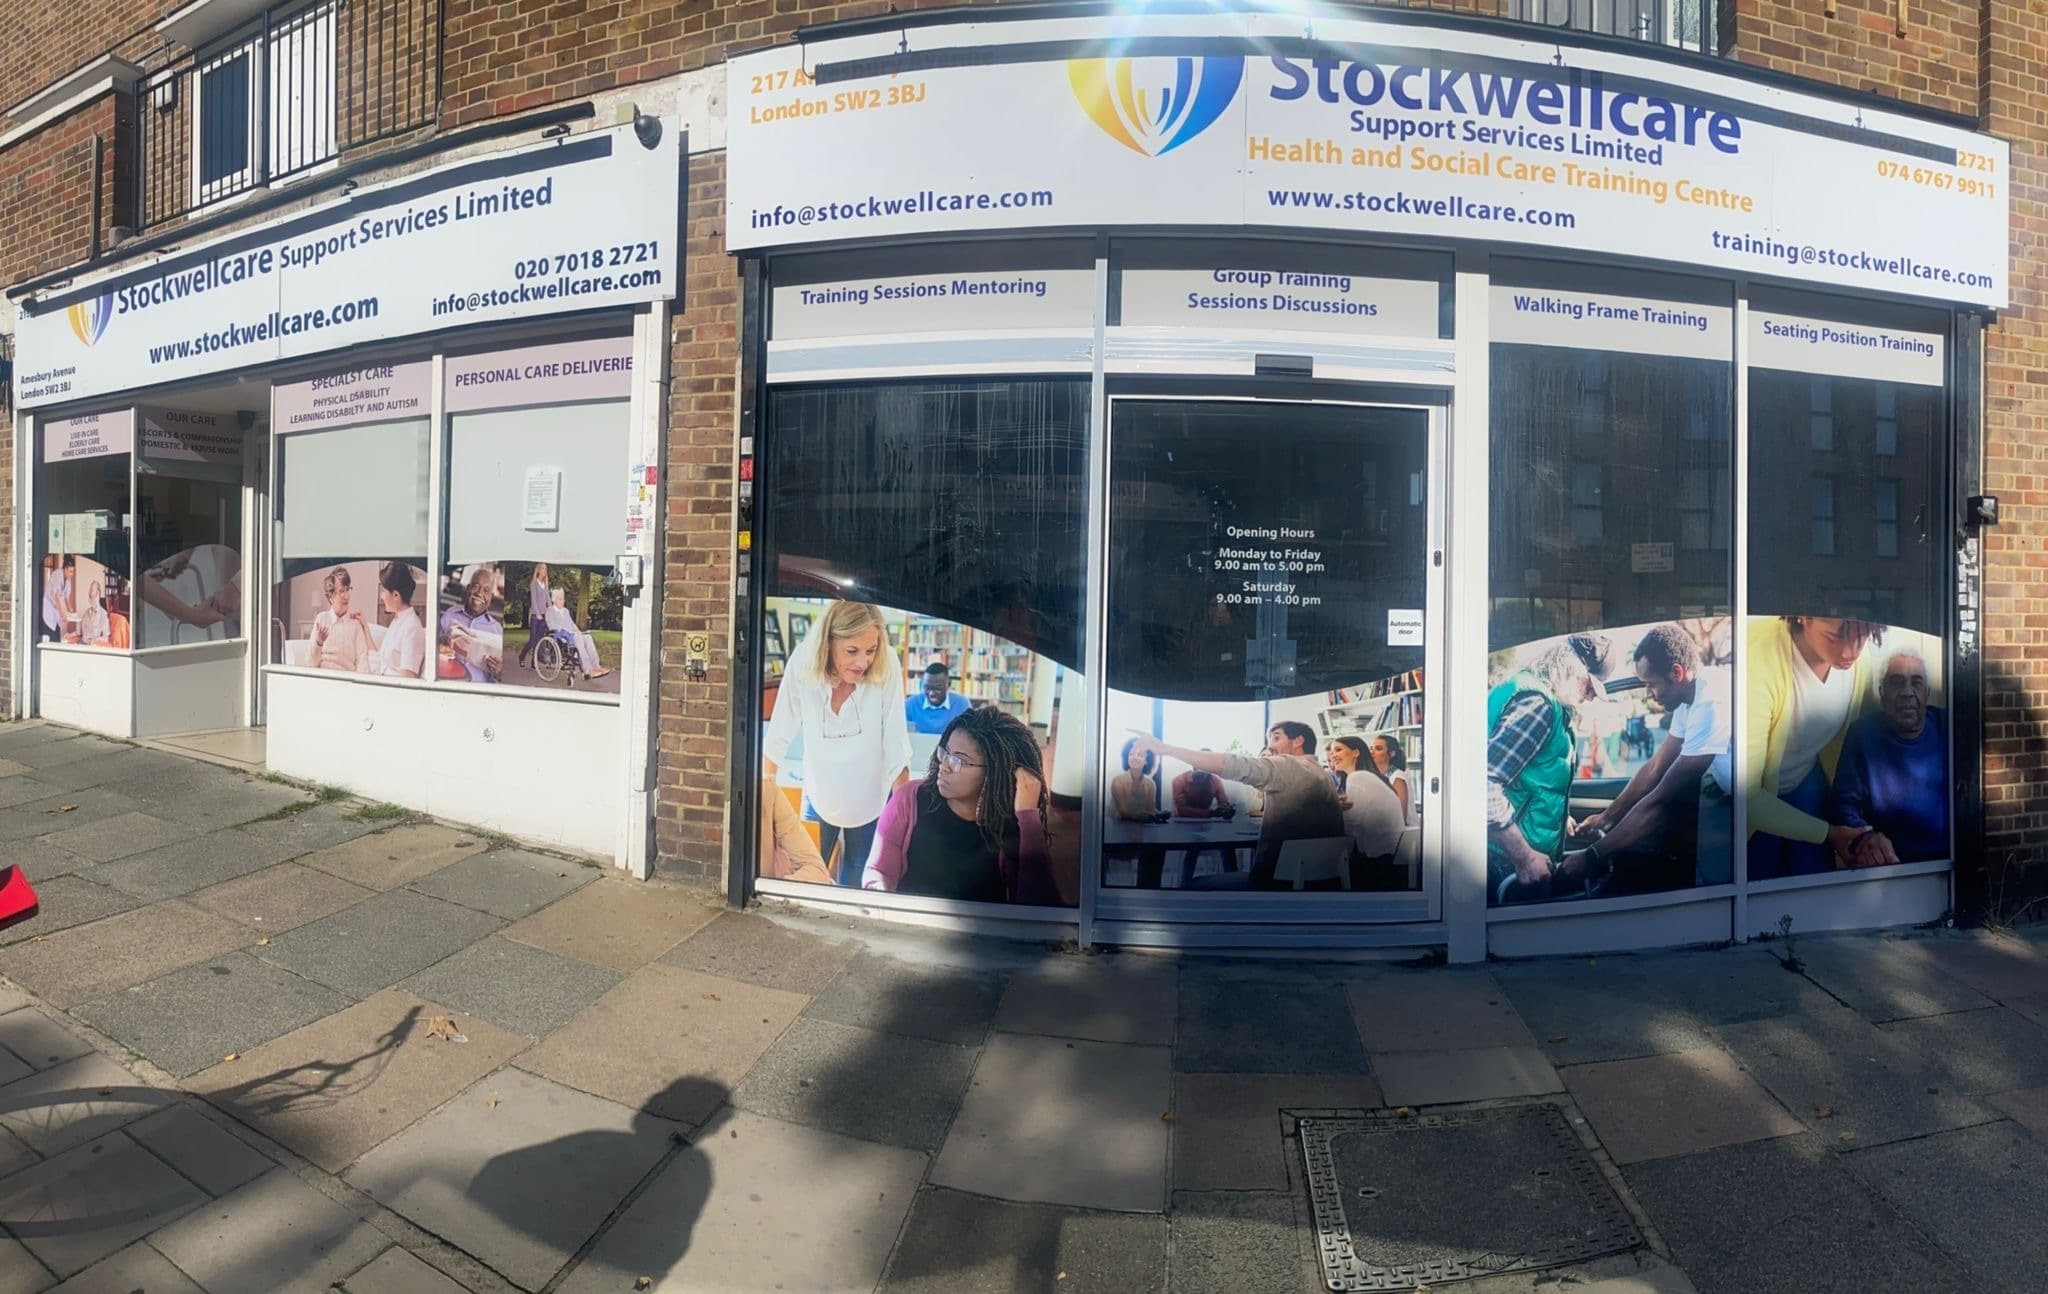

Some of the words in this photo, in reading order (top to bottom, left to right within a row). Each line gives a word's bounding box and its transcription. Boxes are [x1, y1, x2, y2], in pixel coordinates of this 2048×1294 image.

[751, 70, 788, 94] 217
[751, 99, 827, 125] London
[834, 89, 881, 113] SW2
[888, 83, 926, 106] 3BJ
[1269, 53, 1741, 154] Stockwellcare
[1350, 110, 1455, 141] Support
[1462, 120, 1565, 153] Services
[1571, 133, 1663, 166] Limited
[1249, 137, 1342, 164] Health
[1351, 145, 1401, 168] and
[1410, 147, 1489, 176] Social
[1496, 155, 1555, 183] Care
[1563, 162, 1668, 204] Training
[1675, 179, 1753, 212] Centre
[1958, 150, 1995, 173] 2721
[1877, 160, 1909, 182] 074
[1913, 168, 1953, 192] 6767
[1957, 177, 1995, 199] 9911
[751, 190, 1054, 229] info@stockwellcare.com
[1268, 190, 1575, 229] www.stockwellcare.com
[117, 248, 273, 315] Stockwellcare
[280, 228, 357, 270] Support
[359, 205, 448, 244] Services
[455, 177, 552, 221] Limited
[1712, 230, 1993, 289] training@stockwellcare.com
[515, 258, 549, 280] 020
[555, 249, 603, 273] 7018
[609, 240, 658, 266] 2721
[433, 268, 661, 316] info@stockwellcare.com
[800, 288, 869, 305] Training
[873, 281, 946, 300] Sessions
[951, 278, 1046, 297] Mentoring
[1213, 268, 1272, 289] Group
[1276, 271, 1351, 293] Training
[1188, 292, 1268, 311] Sessions
[1273, 295, 1377, 316] Discussions
[1513, 295, 1583, 320] Walking
[1587, 302, 1638, 322] Frame
[1642, 306, 1708, 331] Training
[149, 296, 378, 364] www.stockwellcare.com
[1763, 320, 1818, 344] Seating
[1821, 327, 1877, 348] Position
[1880, 334, 1934, 357] Training
[20, 371, 52, 385] Amesbury
[53, 366, 76, 378] Avenue
[365, 366, 394, 381] CARE
[455, 368, 521, 387] PERSONAL
[524, 364, 559, 379] CARE
[562, 356, 632, 377] DELIVERIE
[20, 387, 45, 399] London
[45, 383, 59, 395] SW2
[60, 381, 71, 392] 3BJ
[313, 394, 347, 407] PHYSICAL
[166, 412, 188, 424] OUR
[190, 414, 217, 426] CARE
[290, 411, 326, 424] LEARNING
[366, 401, 385, 412] AND
[386, 397, 418, 410] AUTISM
[1226, 526, 1277, 540] Opening
[1280, 527, 1315, 538] Hours
[1214, 560, 1240, 571] 9.00
[1242, 563, 1260, 571] am
[1263, 561, 1276, 571] to
[1279, 561, 1303, 572] 5.00
[1306, 563, 1325, 573] pm
[1219, 548, 1267, 560] Monday
[1270, 549, 1282, 559] to
[1285, 549, 1321, 562] Friday
[1216, 594, 1242, 604] 9.00
[1244, 596, 1262, 604] am
[1274, 595, 1300, 605] 4.00
[1302, 597, 1321, 607] pm
[1243, 581, 1296, 594] Saturday
[1389, 620, 1422, 628] Automatic
